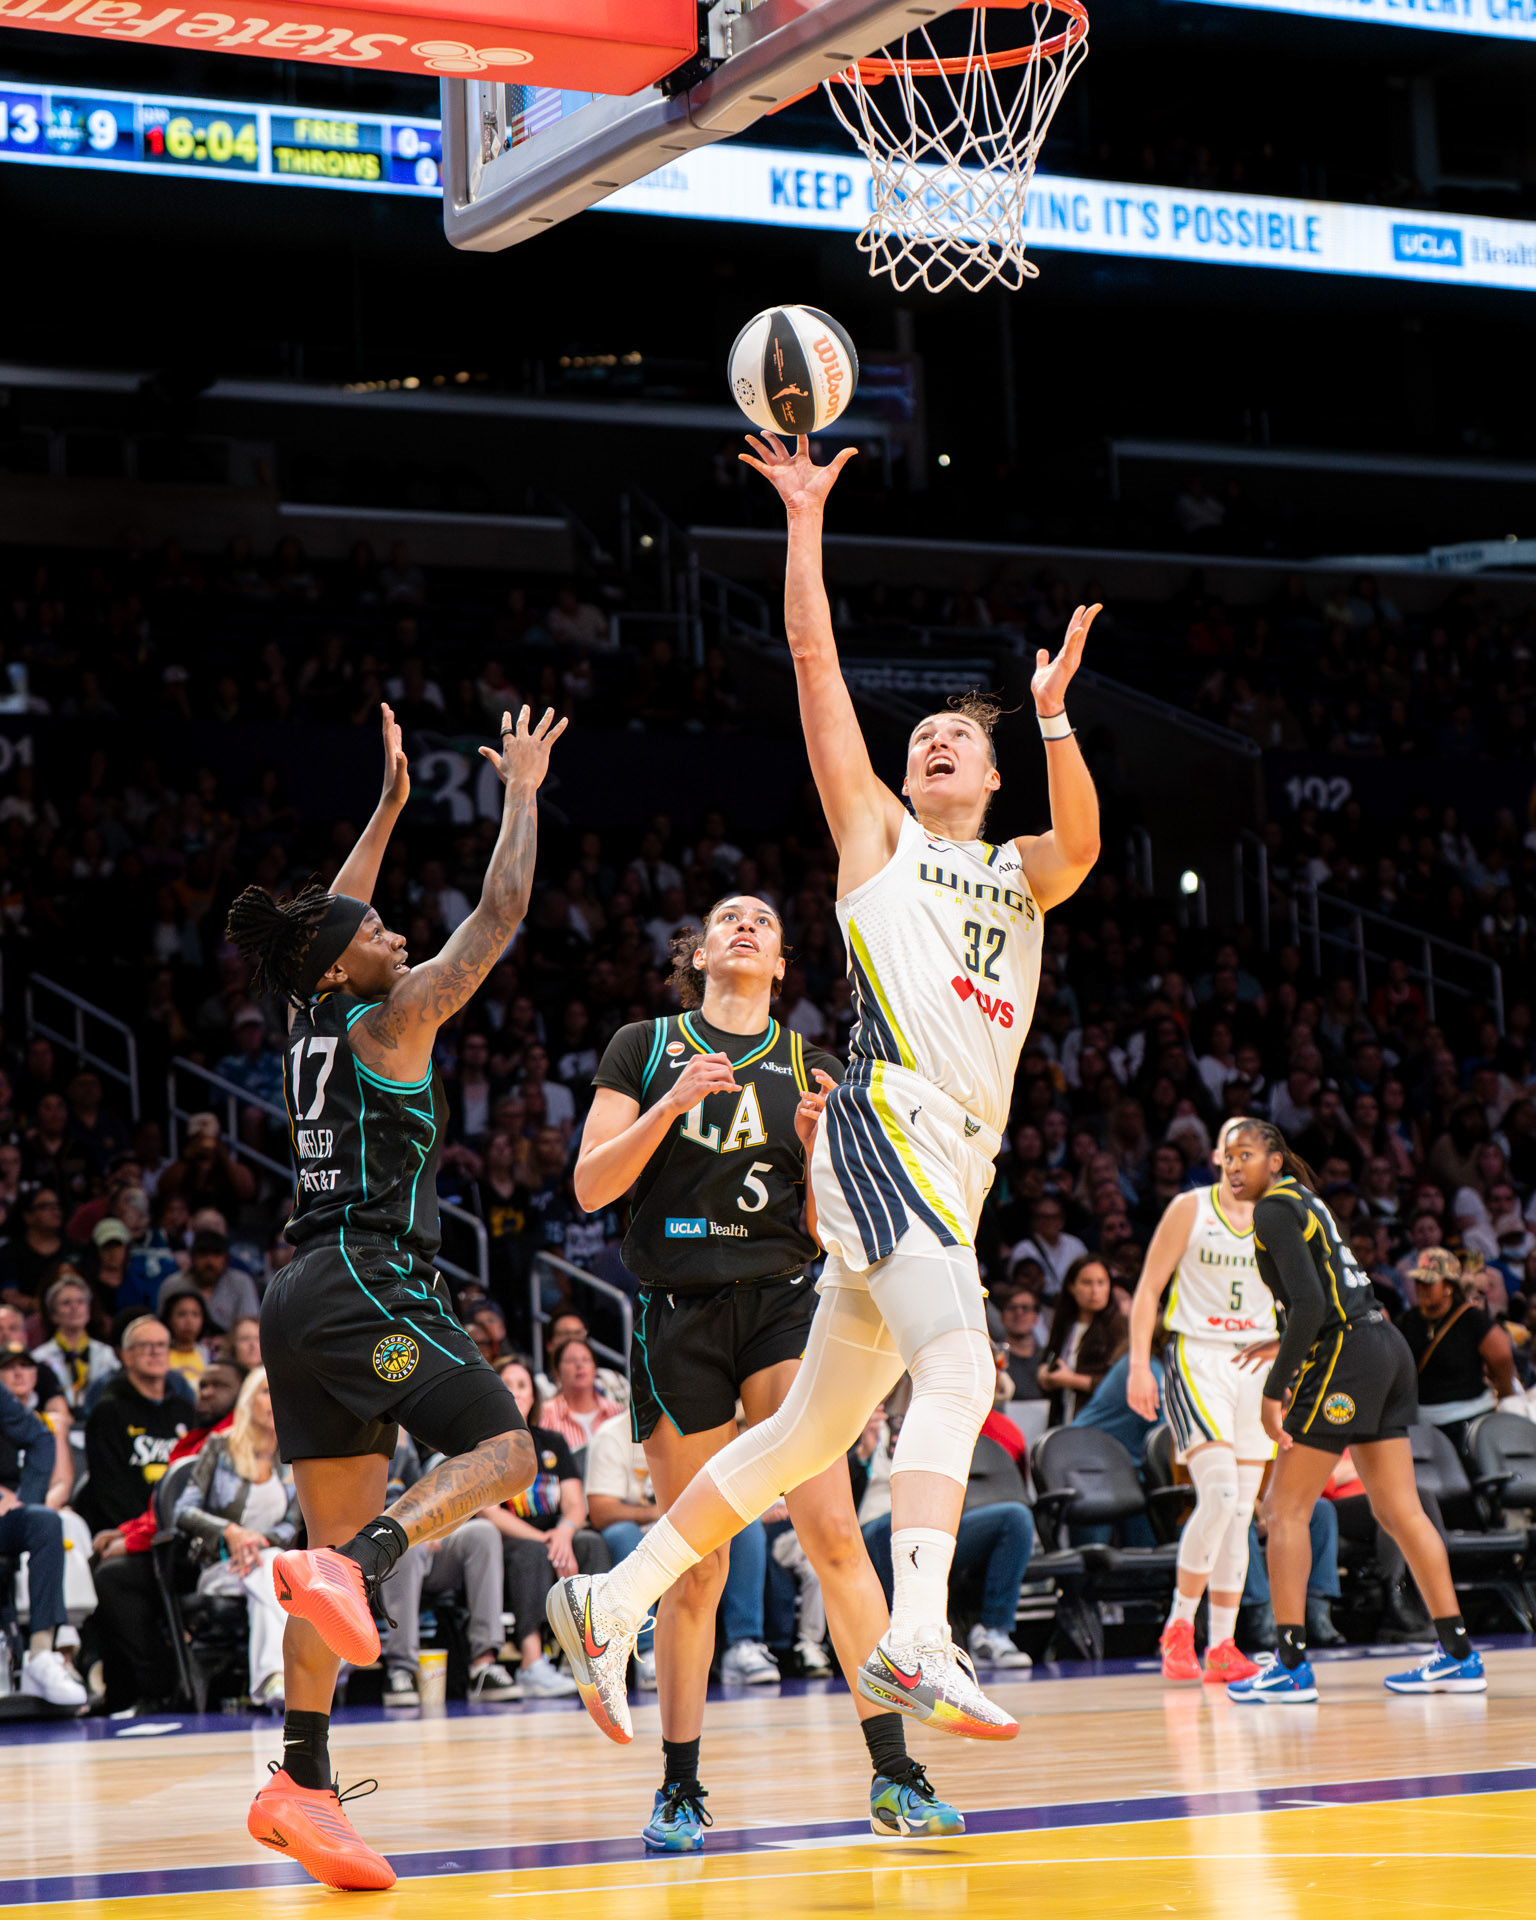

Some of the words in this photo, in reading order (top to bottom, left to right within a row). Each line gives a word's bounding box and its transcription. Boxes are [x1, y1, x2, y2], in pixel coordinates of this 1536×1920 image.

[87, 109, 118, 152] 9
[165, 116, 258, 164] 6:04
[293, 118, 360, 148] FREE
[273, 146, 381, 181] THROWS
[769, 166, 853, 211] KEEP
[1103, 196, 1160, 240] IT'S
[1171, 203, 1323, 254] POSSIBLE
[1399, 231, 1459, 259] UCLA
[812, 334, 844, 421] Wilson
[917, 860, 1036, 923] WINGS
[962, 917, 1008, 986] 32
[290, 1036, 339, 1121] 17
[760, 1061, 793, 1077] Albert
[680, 1081, 769, 1154] LA
[304, 1169, 342, 1192] AT&T
[736, 1160, 774, 1213] 5
[669, 1222, 702, 1235] UCLA
[1230, 1281, 1244, 1312] 5
